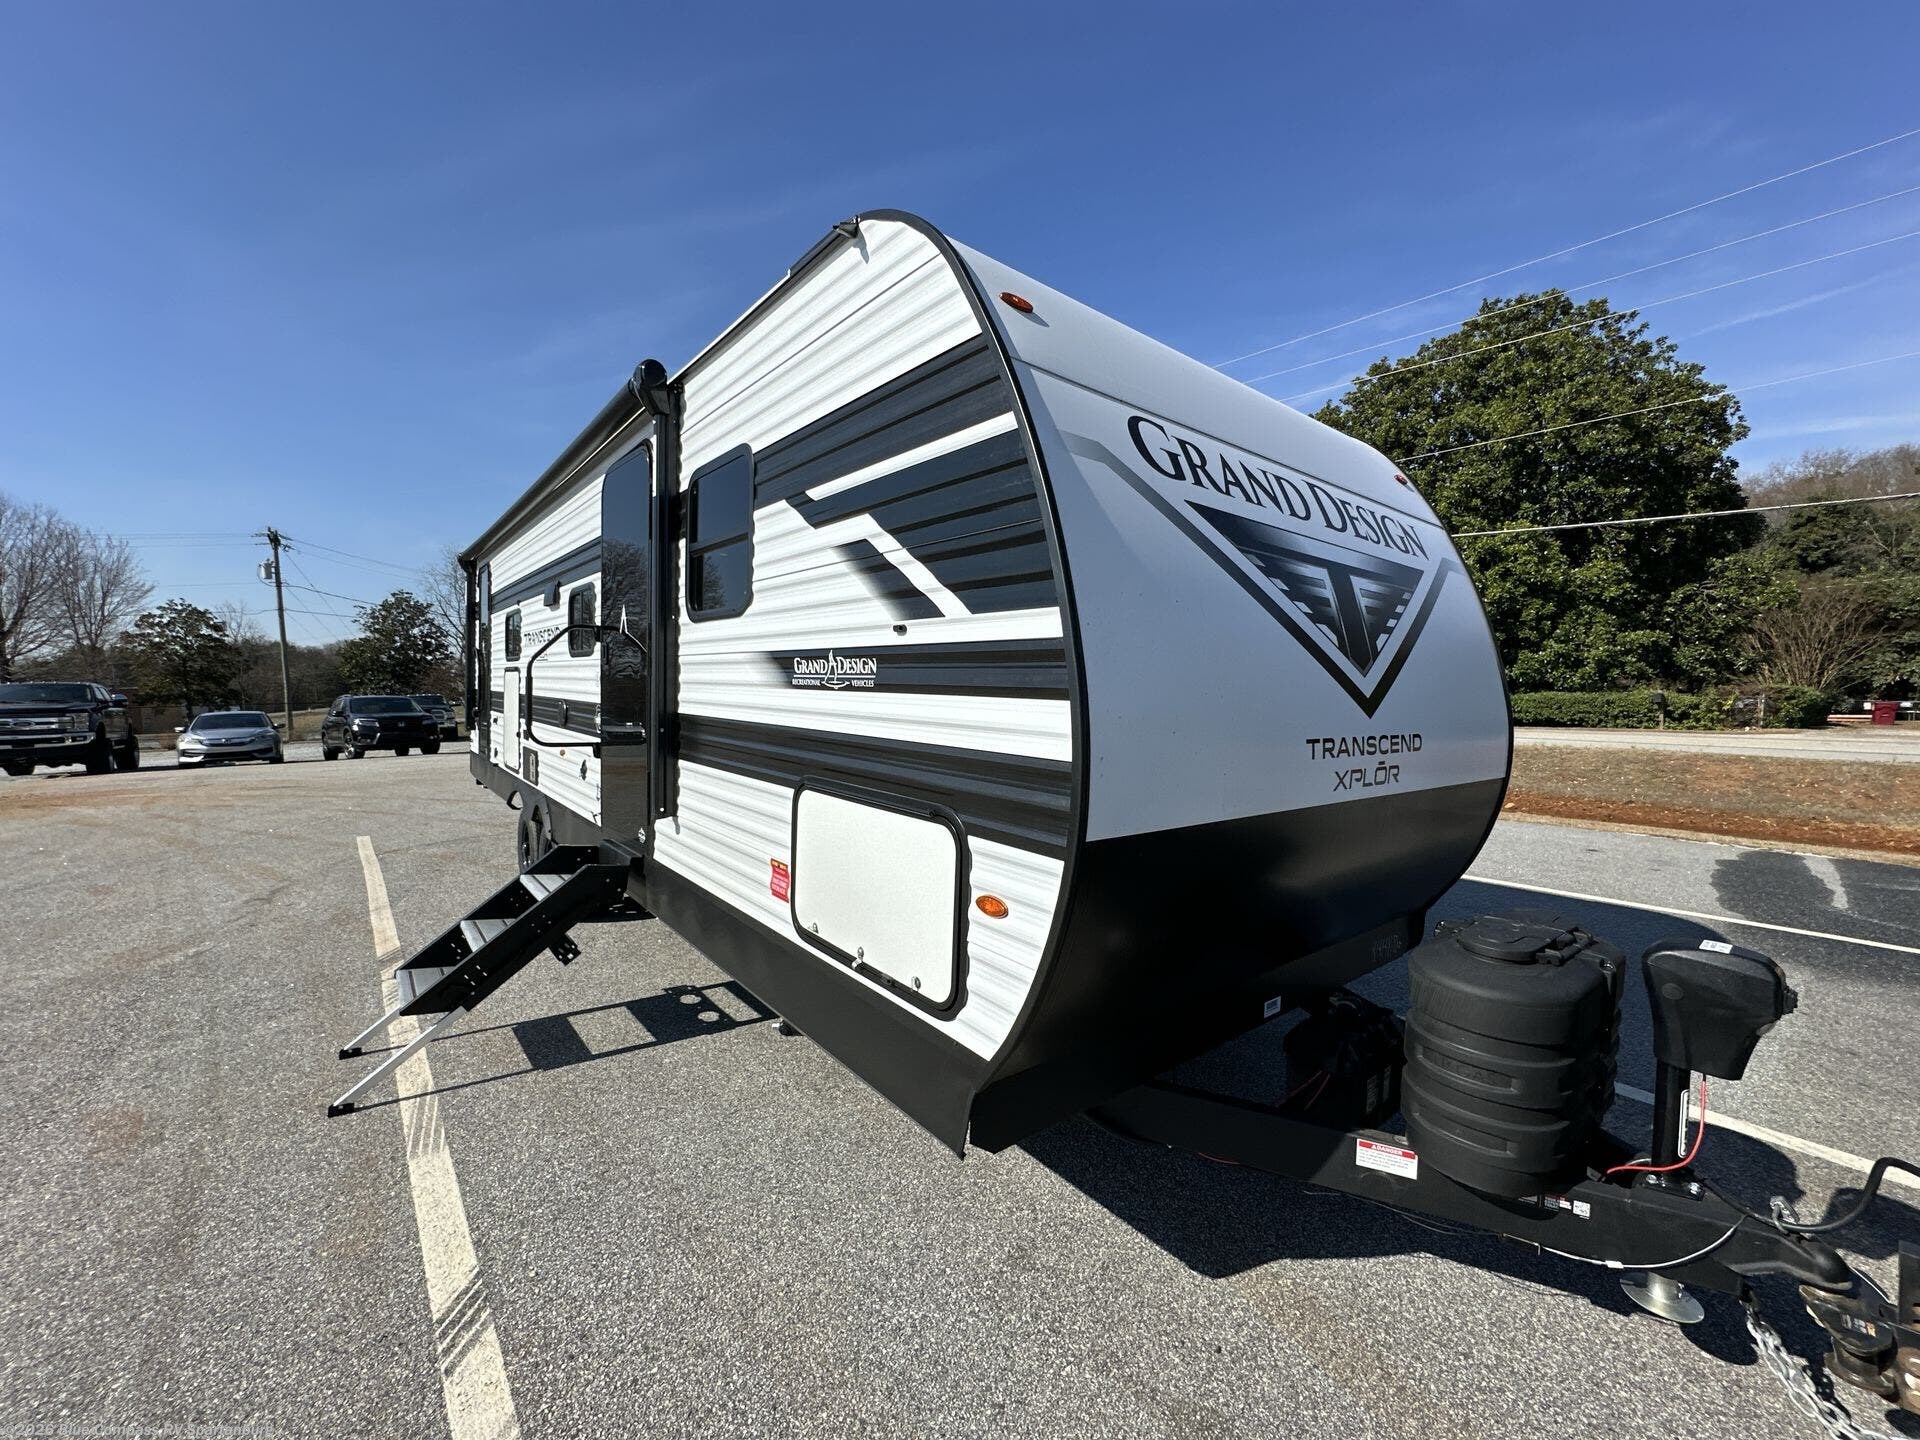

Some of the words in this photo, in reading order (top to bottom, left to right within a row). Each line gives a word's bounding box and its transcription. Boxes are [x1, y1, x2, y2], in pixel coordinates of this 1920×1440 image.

[1127, 415, 1311, 521] GRAND
[1304, 480, 1430, 560] DESIGN
[793, 657, 828, 674] GRAND
[836, 656, 877, 674] DESIGN
[1306, 733, 1422, 760] TRANSCEND
